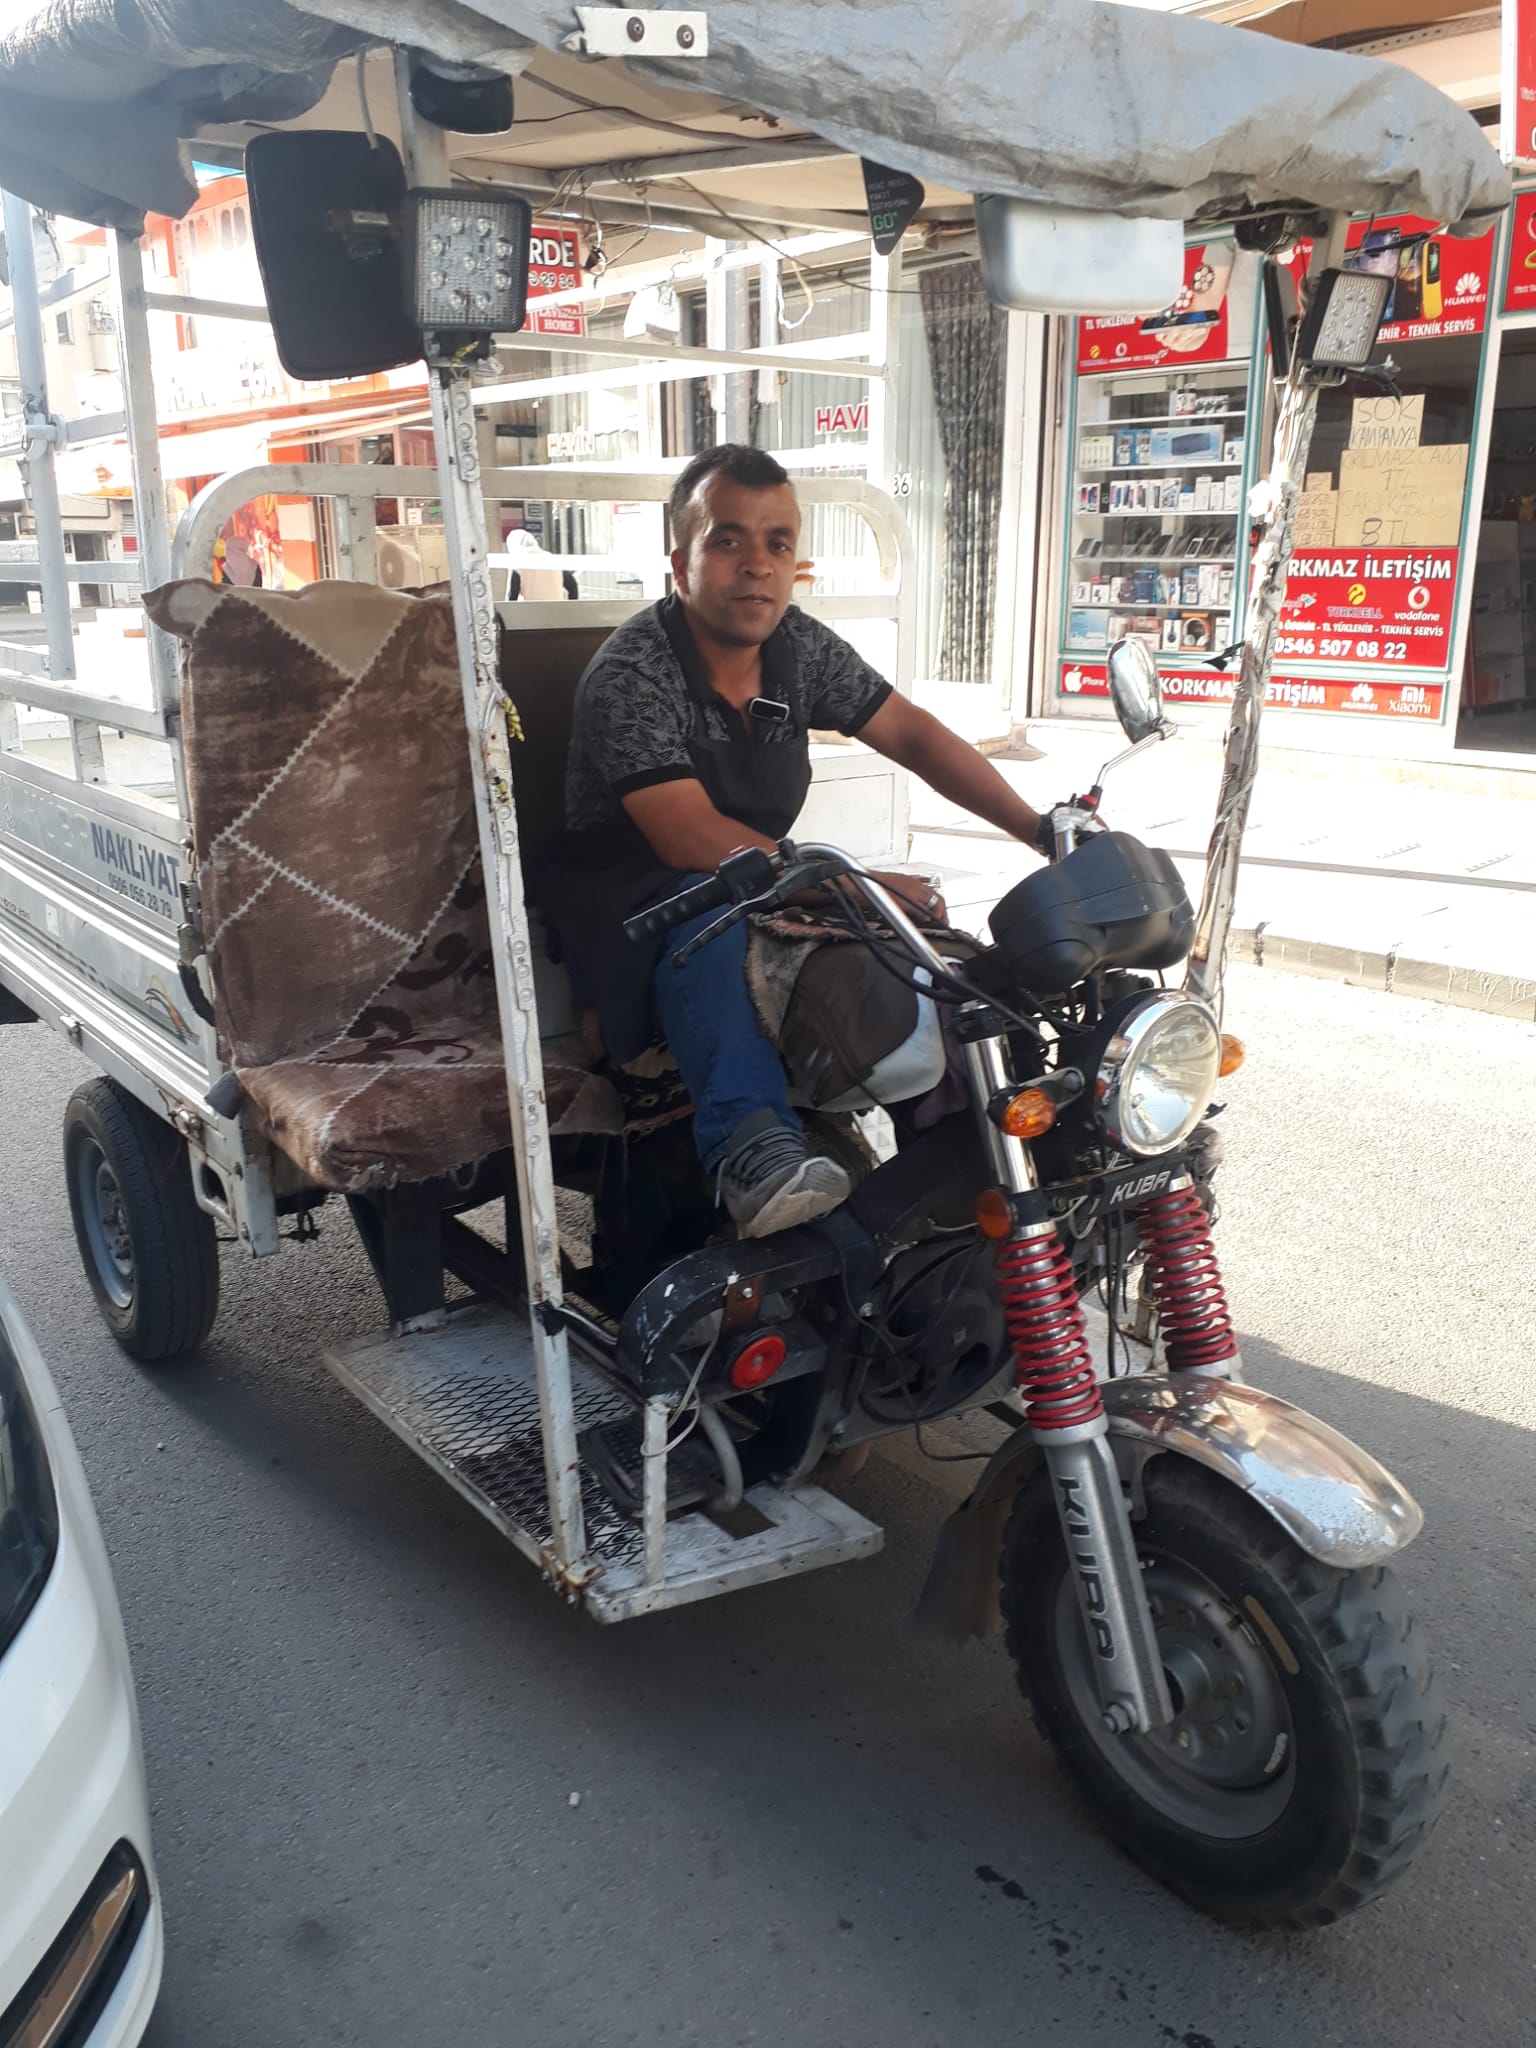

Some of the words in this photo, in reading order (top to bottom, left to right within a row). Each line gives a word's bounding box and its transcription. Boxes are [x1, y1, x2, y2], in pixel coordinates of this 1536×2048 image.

[1444, 293, 1486, 307] HUAWEI
[1408, 318, 1441, 338] TEKNİK
[1443, 315, 1476, 335] SERVİS
[1351, 426, 1418, 448] KAMPANYA
[1287, 558, 1359, 578] RKMAZ
[1364, 553, 1452, 584] İLETİŞİM
[1394, 610, 1440, 622] vodafone
[1380, 622, 1412, 636] TEKNİK
[1413, 624, 1444, 637] SERVİS
[1275, 636, 1316, 654] 0546
[1319, 638, 1353, 656] 507
[1356, 640, 1380, 658] 08
[1383, 641, 1407, 660] 22
[1388, 699, 1431, 715] Xiaomi
[1109, 1170, 1172, 1205] KUBA
